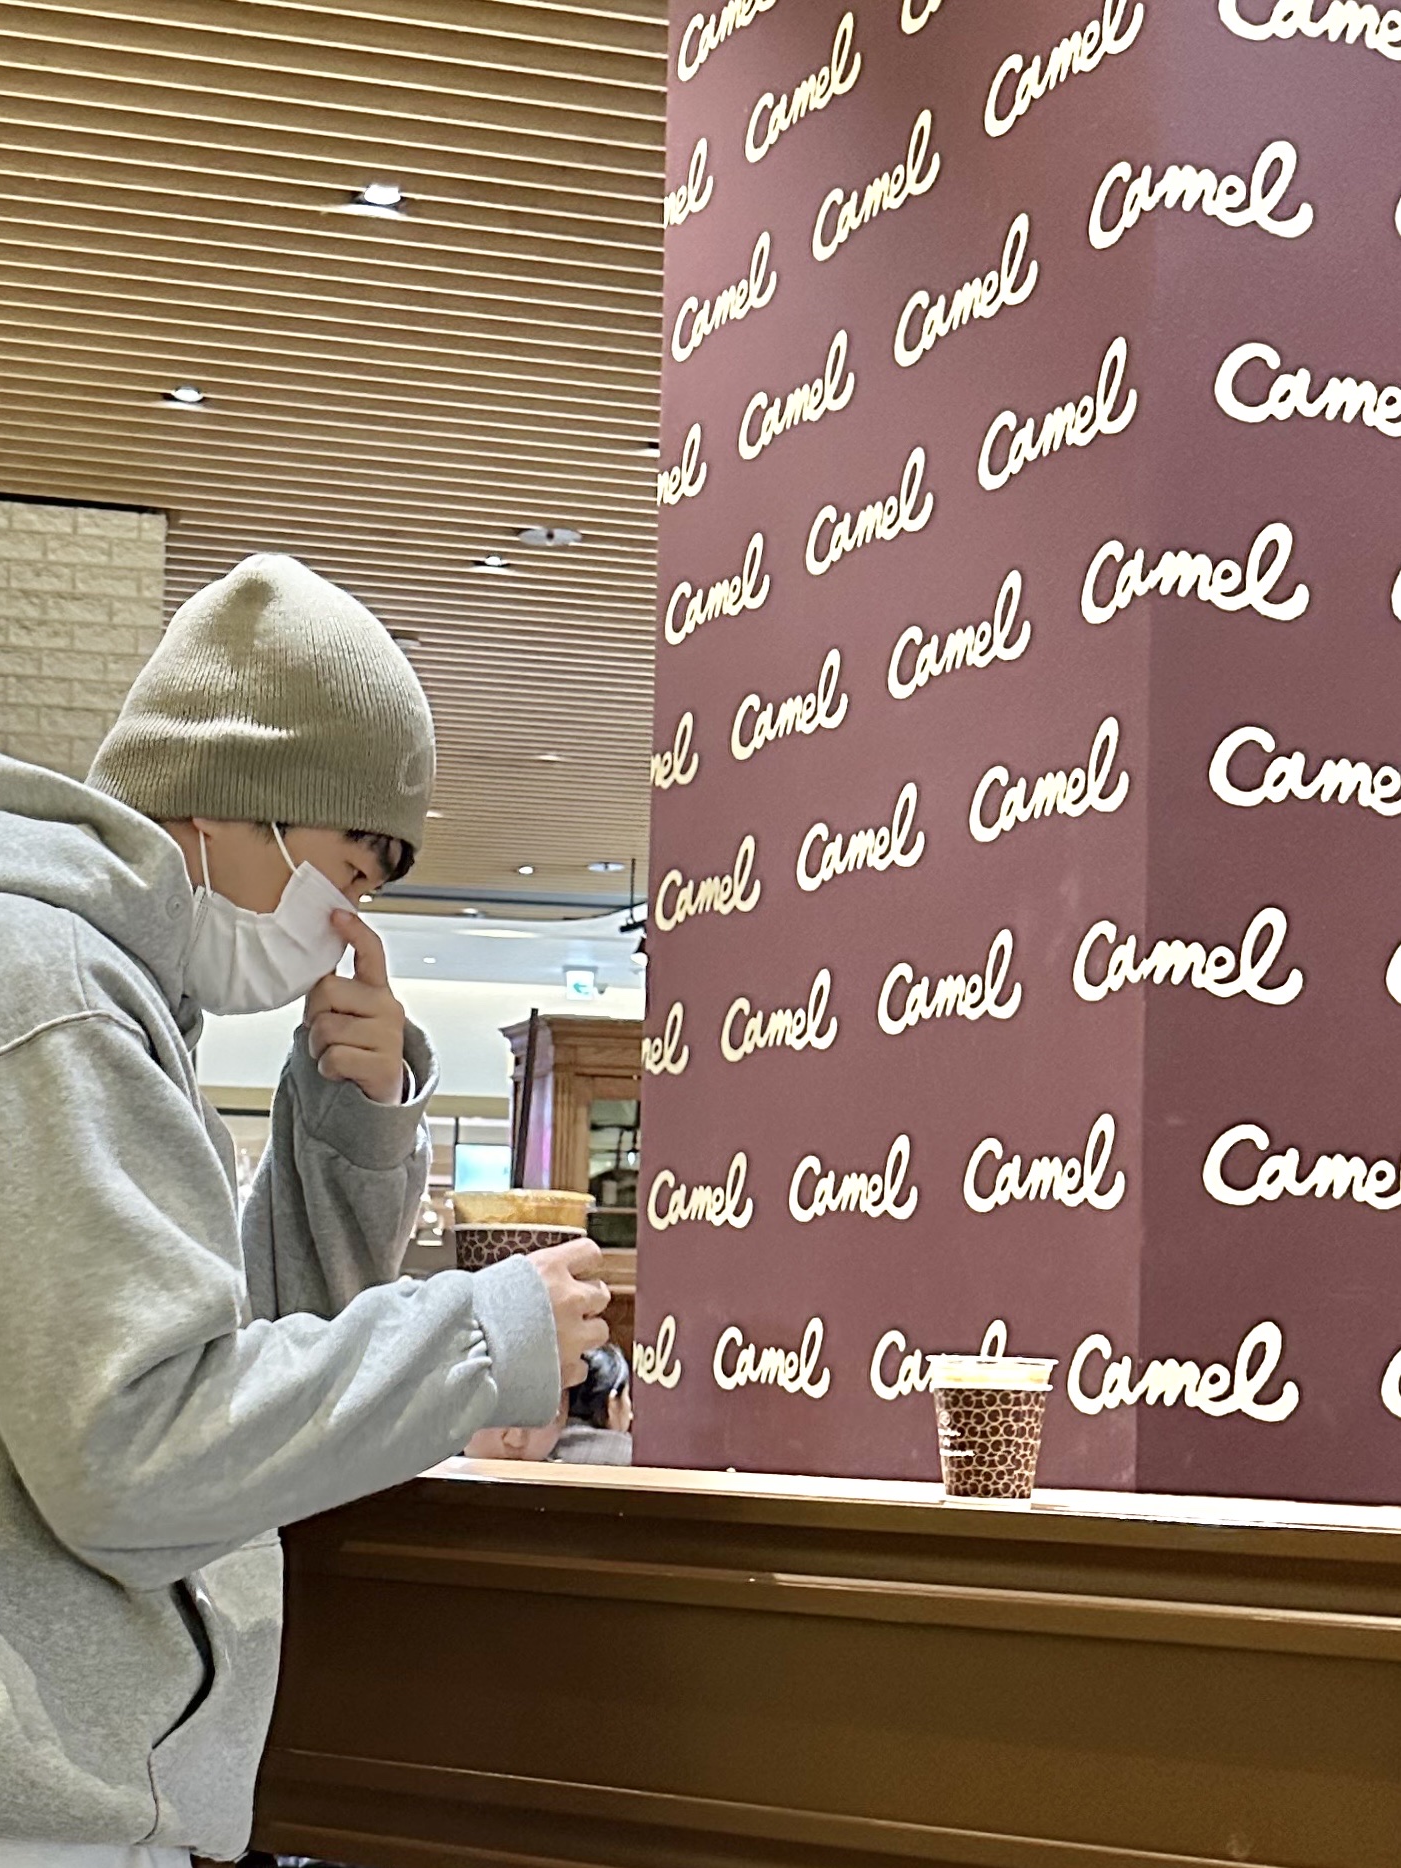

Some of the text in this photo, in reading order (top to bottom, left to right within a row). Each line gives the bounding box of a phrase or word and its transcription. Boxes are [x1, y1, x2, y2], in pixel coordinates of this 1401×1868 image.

[677, 0, 777, 82] Came
[984, 0, 1144, 138] Camel
[1217, 0, 1401, 61] Came
[745, 12, 861, 163] Camel
[813, 109, 940, 262] Camel
[1088, 140, 1314, 250] Camel
[672, 231, 776, 363] Camel
[895, 212, 1038, 367] Camel
[738, 329, 855, 460] Camel
[977, 336, 1138, 491] Camel
[1214, 342, 1401, 437] Came
[805, 446, 934, 576] Camel
[664, 532, 770, 645] Camel
[1080, 522, 1310, 624] Camel
[887, 569, 1031, 700] Camel
[731, 648, 849, 761] Camel
[969, 716, 1129, 843] Camel
[1208, 726, 1401, 816] Came
[655, 835, 761, 931] Camel
[796, 782, 925, 892] Camel
[877, 928, 1022, 1035] Camel
[1072, 907, 1304, 1005] Camel
[721, 968, 838, 1062] Camel
[647, 1151, 753, 1230] Camel
[788, 1134, 918, 1223] Camel
[963, 1113, 1126, 1213] Camel
[1202, 1124, 1401, 1210] Came
[713, 1317, 831, 1399] Camel
[1067, 1321, 1299, 1422] Camel
